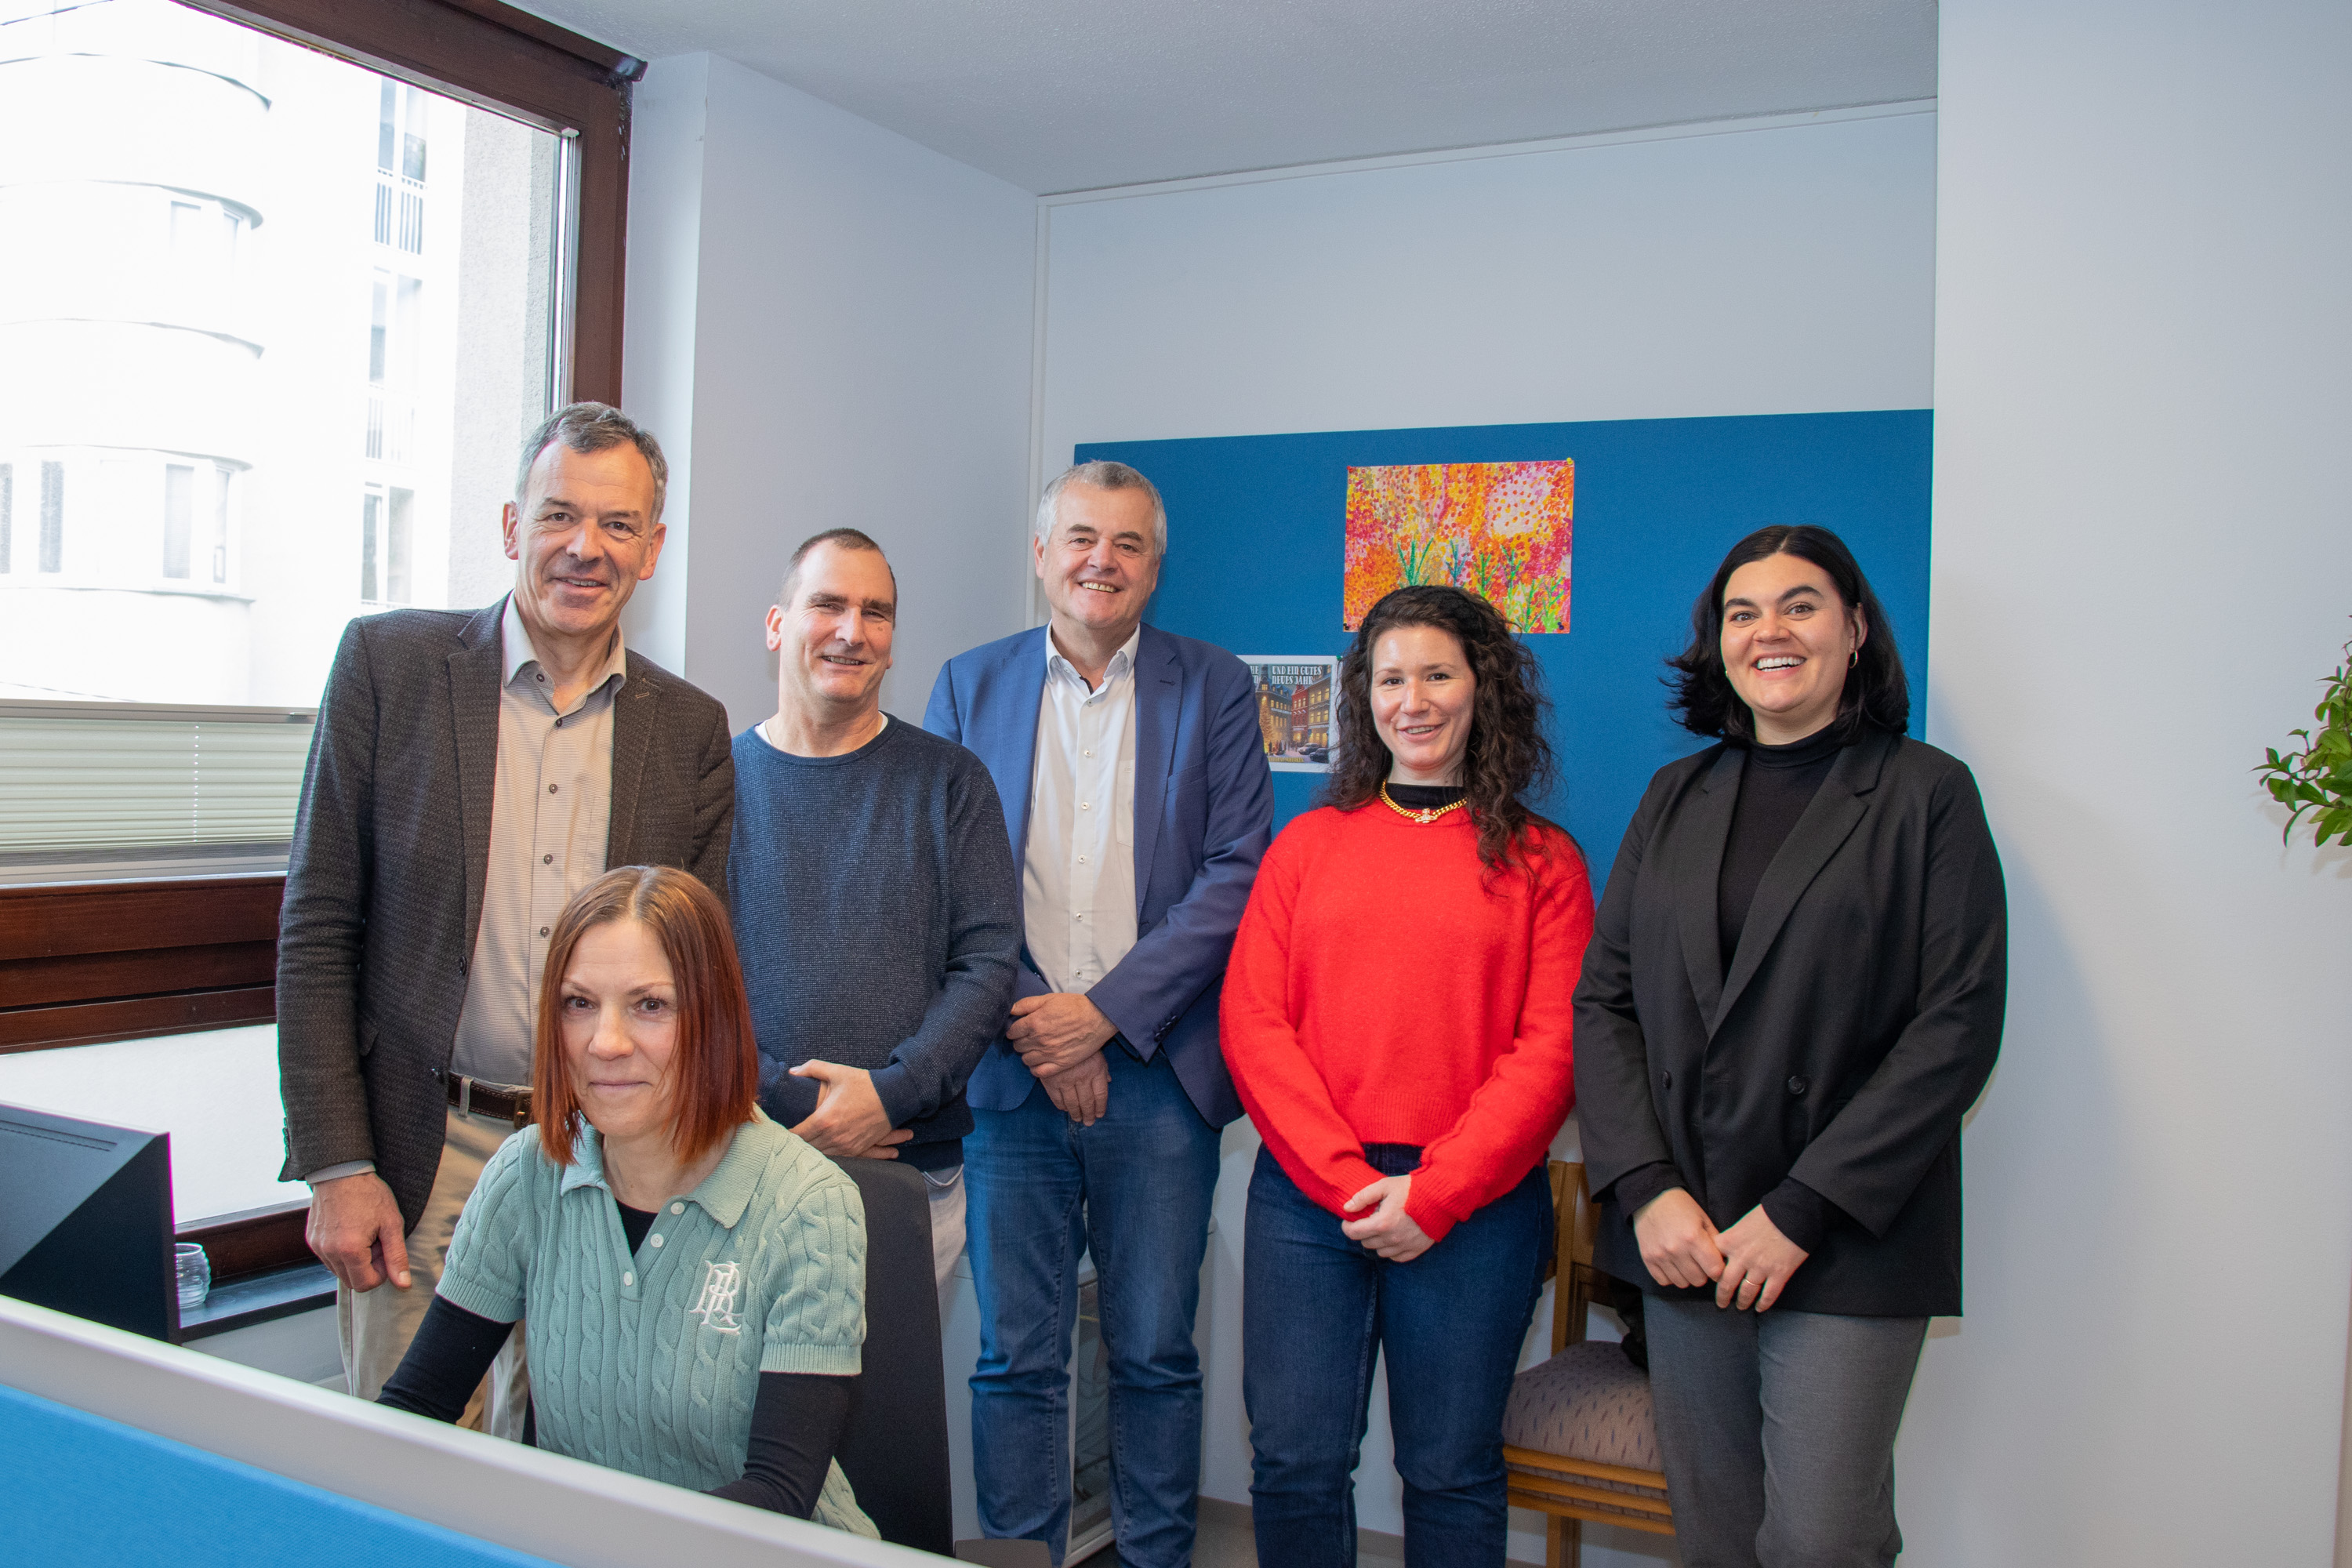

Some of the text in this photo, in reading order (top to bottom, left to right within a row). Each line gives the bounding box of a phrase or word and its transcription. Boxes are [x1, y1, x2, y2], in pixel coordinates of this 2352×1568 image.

[1272, 666, 1323, 676] UND EIN GUTES
[1272, 675, 1314, 685] NEUES JAHR
